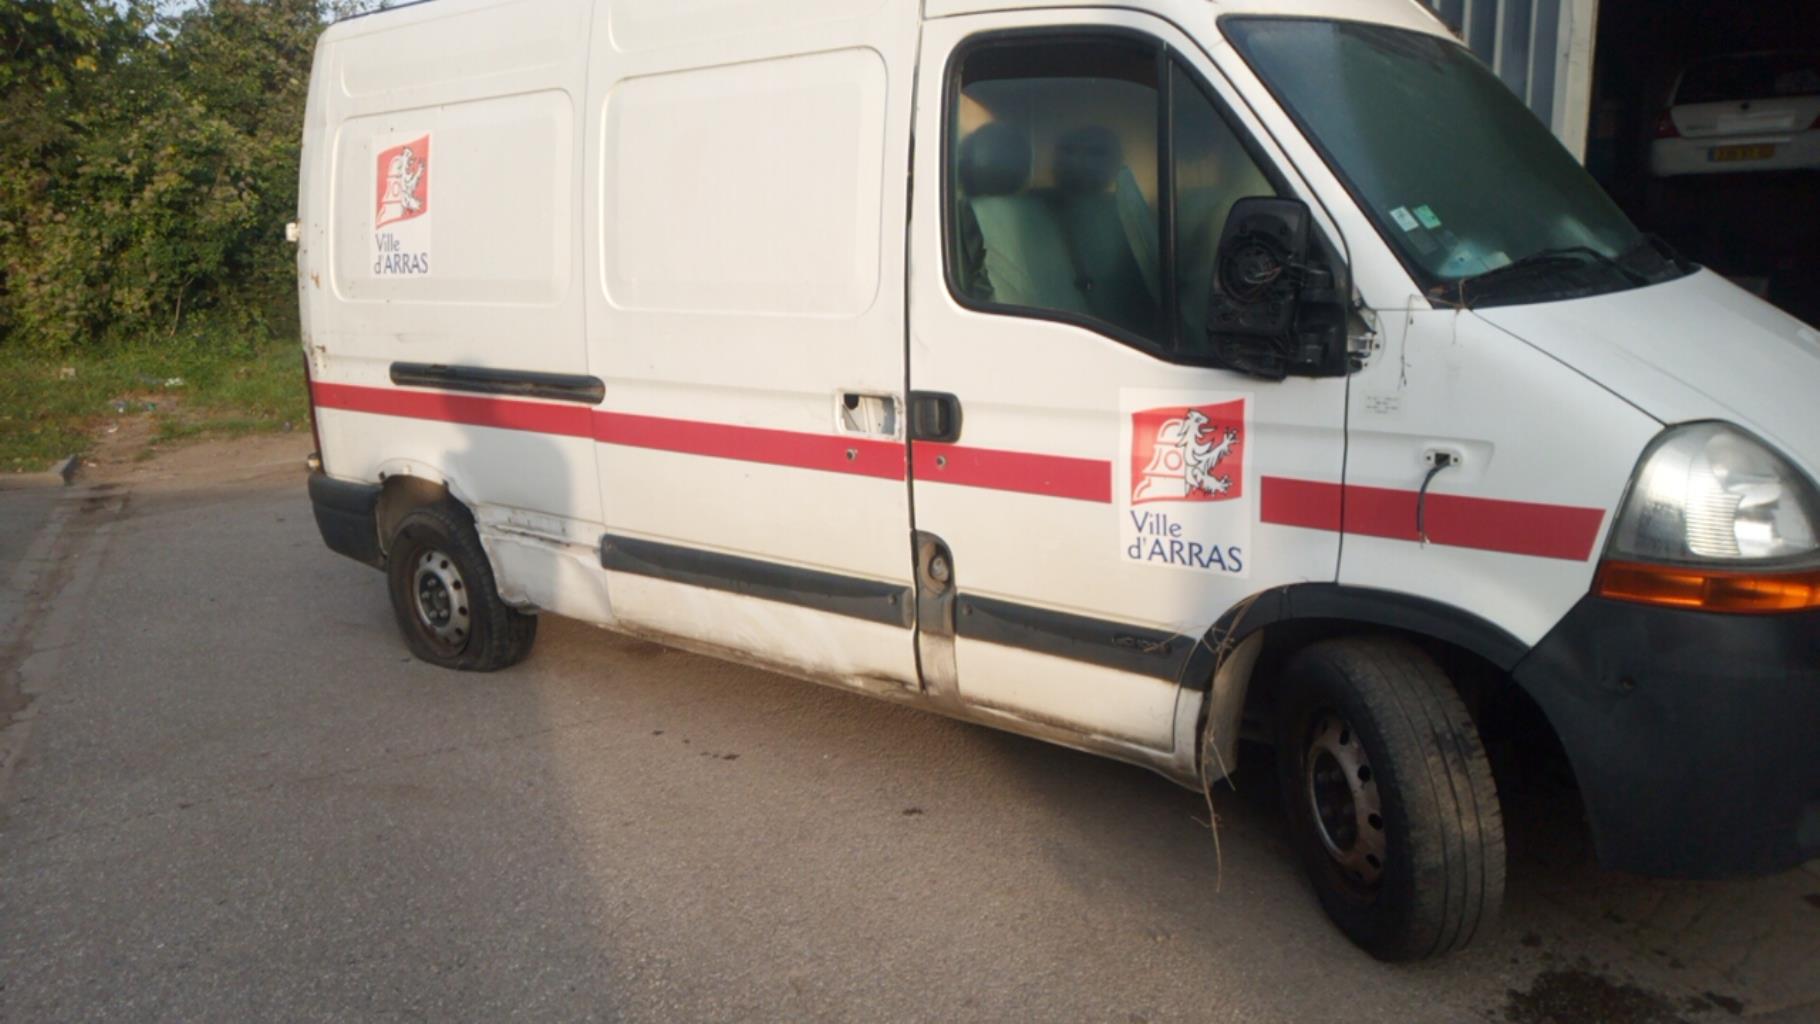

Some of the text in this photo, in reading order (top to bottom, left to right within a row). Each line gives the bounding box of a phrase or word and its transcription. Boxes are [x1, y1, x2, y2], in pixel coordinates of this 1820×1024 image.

[375, 232, 400, 252] Ville
[374, 252, 428, 275] d'ARRAS
[1130, 510, 1182, 537] Ville
[1128, 536, 1243, 573] d'ARRAS
